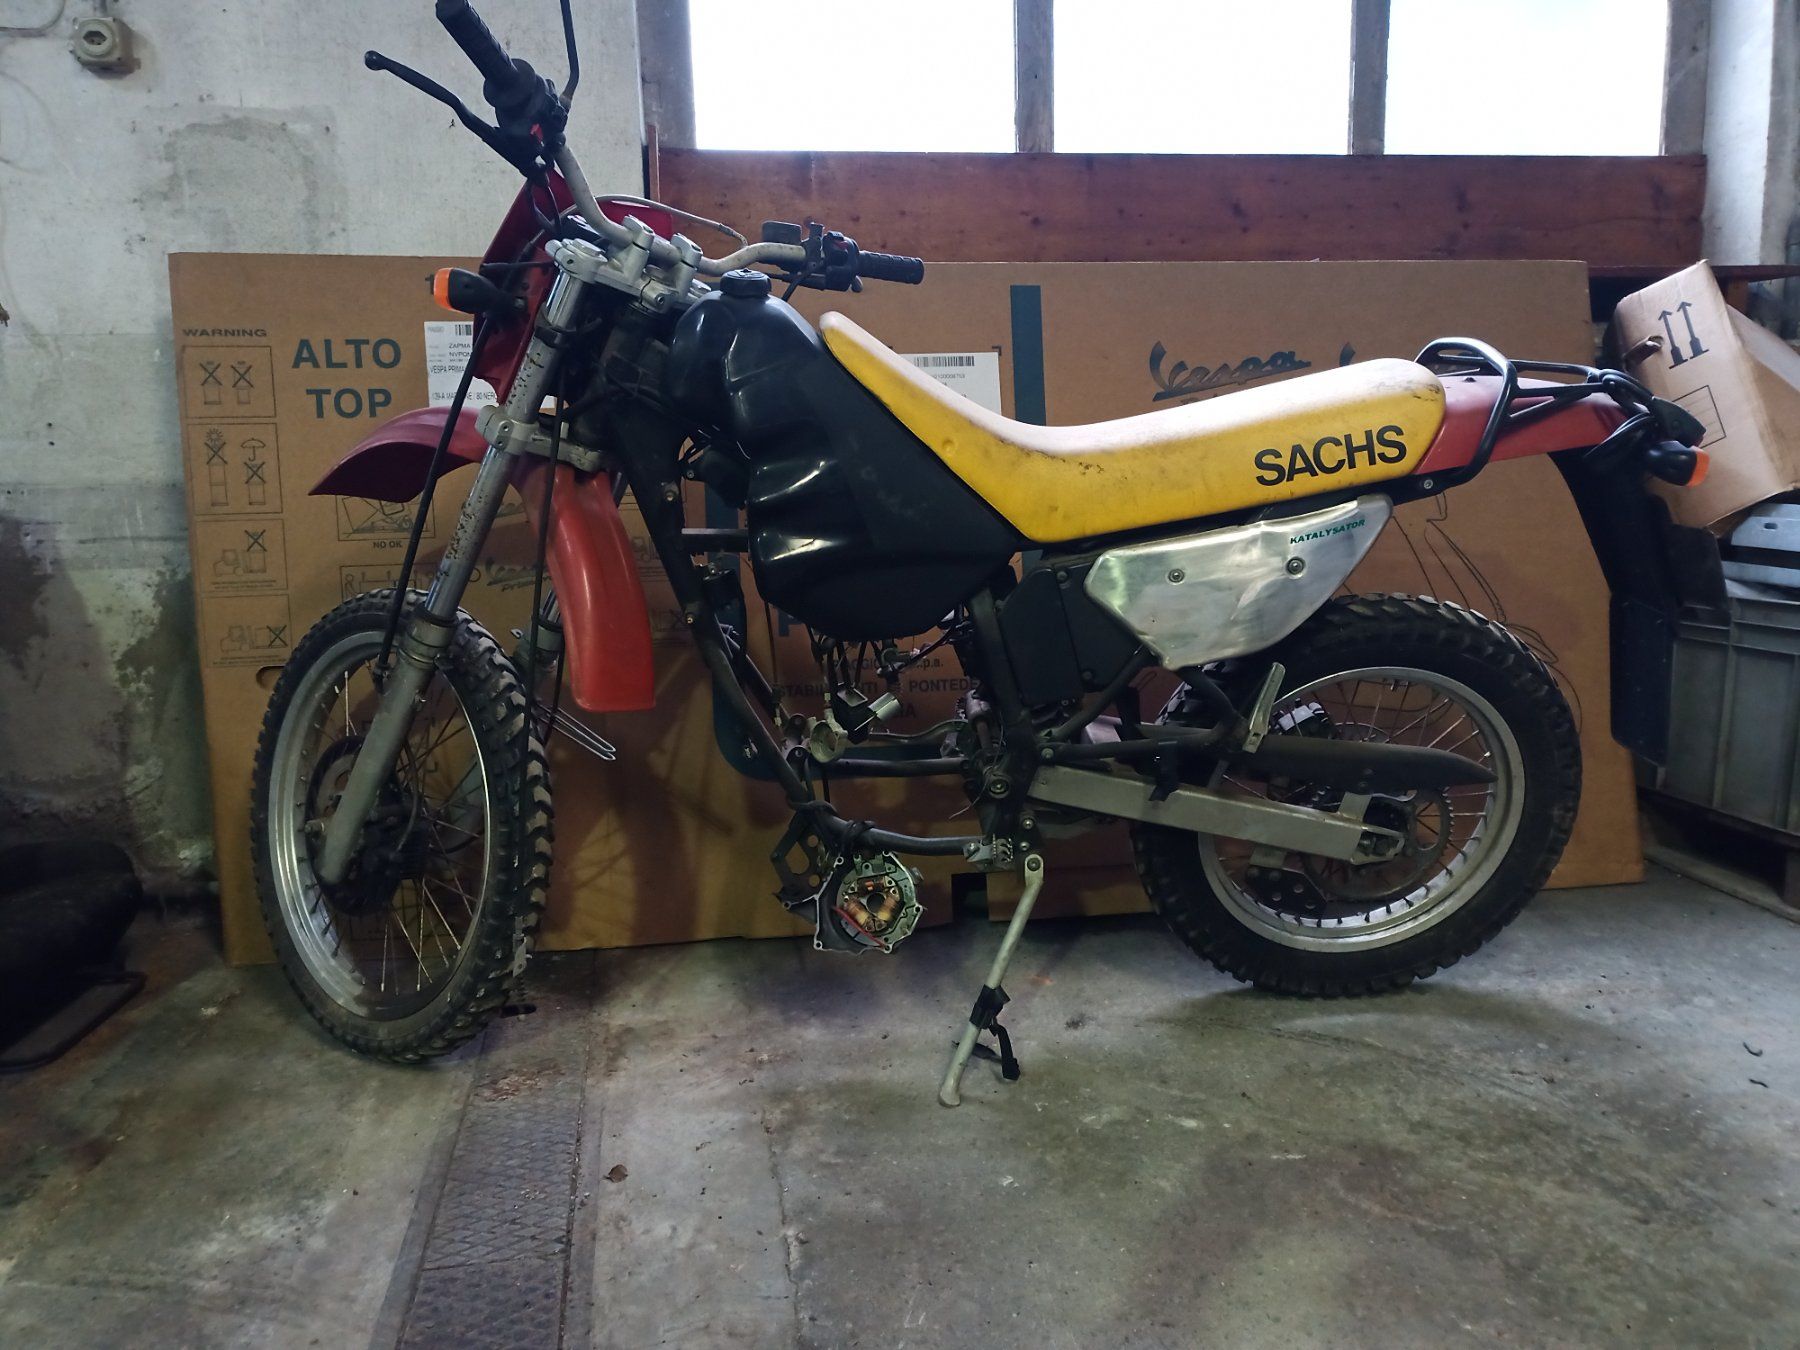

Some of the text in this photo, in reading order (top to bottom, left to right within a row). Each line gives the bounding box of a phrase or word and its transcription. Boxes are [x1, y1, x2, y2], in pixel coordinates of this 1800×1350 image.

[183, 328, 267, 337] WARNING
[292, 338, 401, 368] ALTO
[1150, 341, 1311, 402] Vespa
[306, 388, 392, 418] TOP
[1254, 425, 1407, 486] SACHS
[373, 540, 402, 549] NO OK
[1290, 519, 1365, 545] KATALYSATOR
